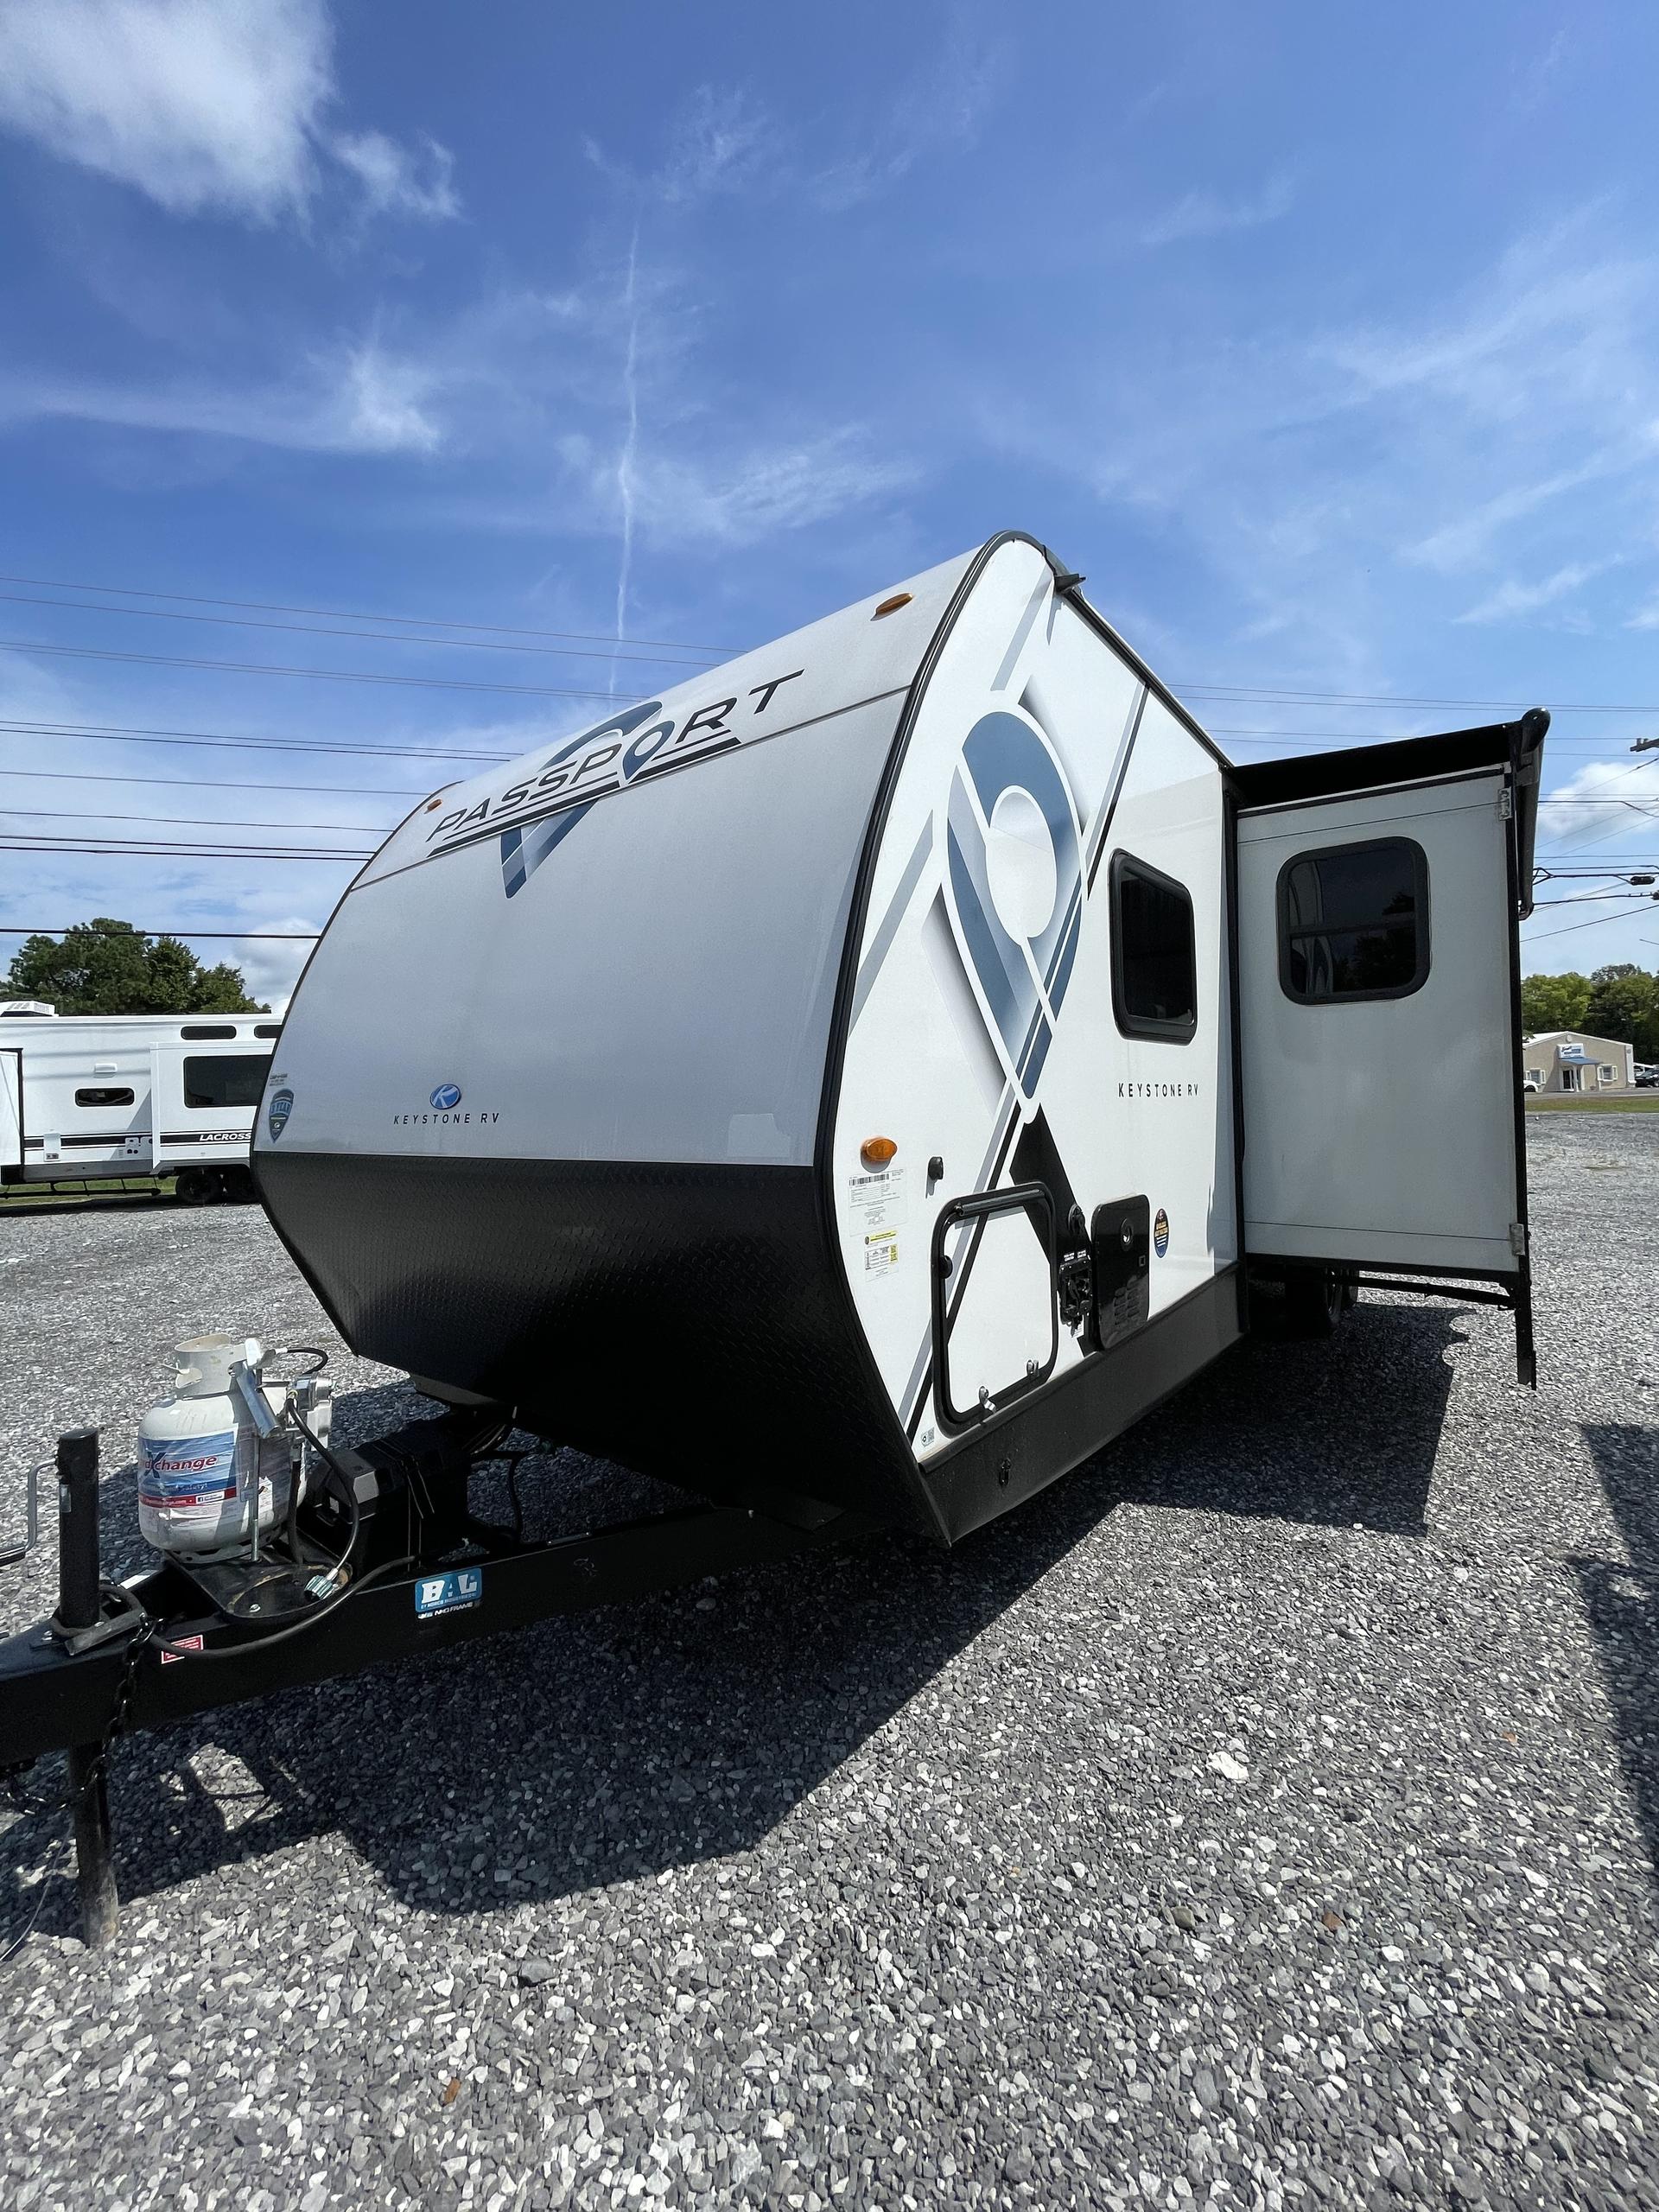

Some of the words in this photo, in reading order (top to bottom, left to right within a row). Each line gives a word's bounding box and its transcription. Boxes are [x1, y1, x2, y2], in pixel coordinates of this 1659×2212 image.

[426, 669, 804, 842] PASSPORT
[1118, 1083, 1181, 1097] KEYSTONE
[1187, 1084, 1198, 1096] RV
[393, 1114, 471, 1125] KEYSTONE
[480, 1112, 499, 1124] RV
[421, 1573, 478, 1605] BAL
